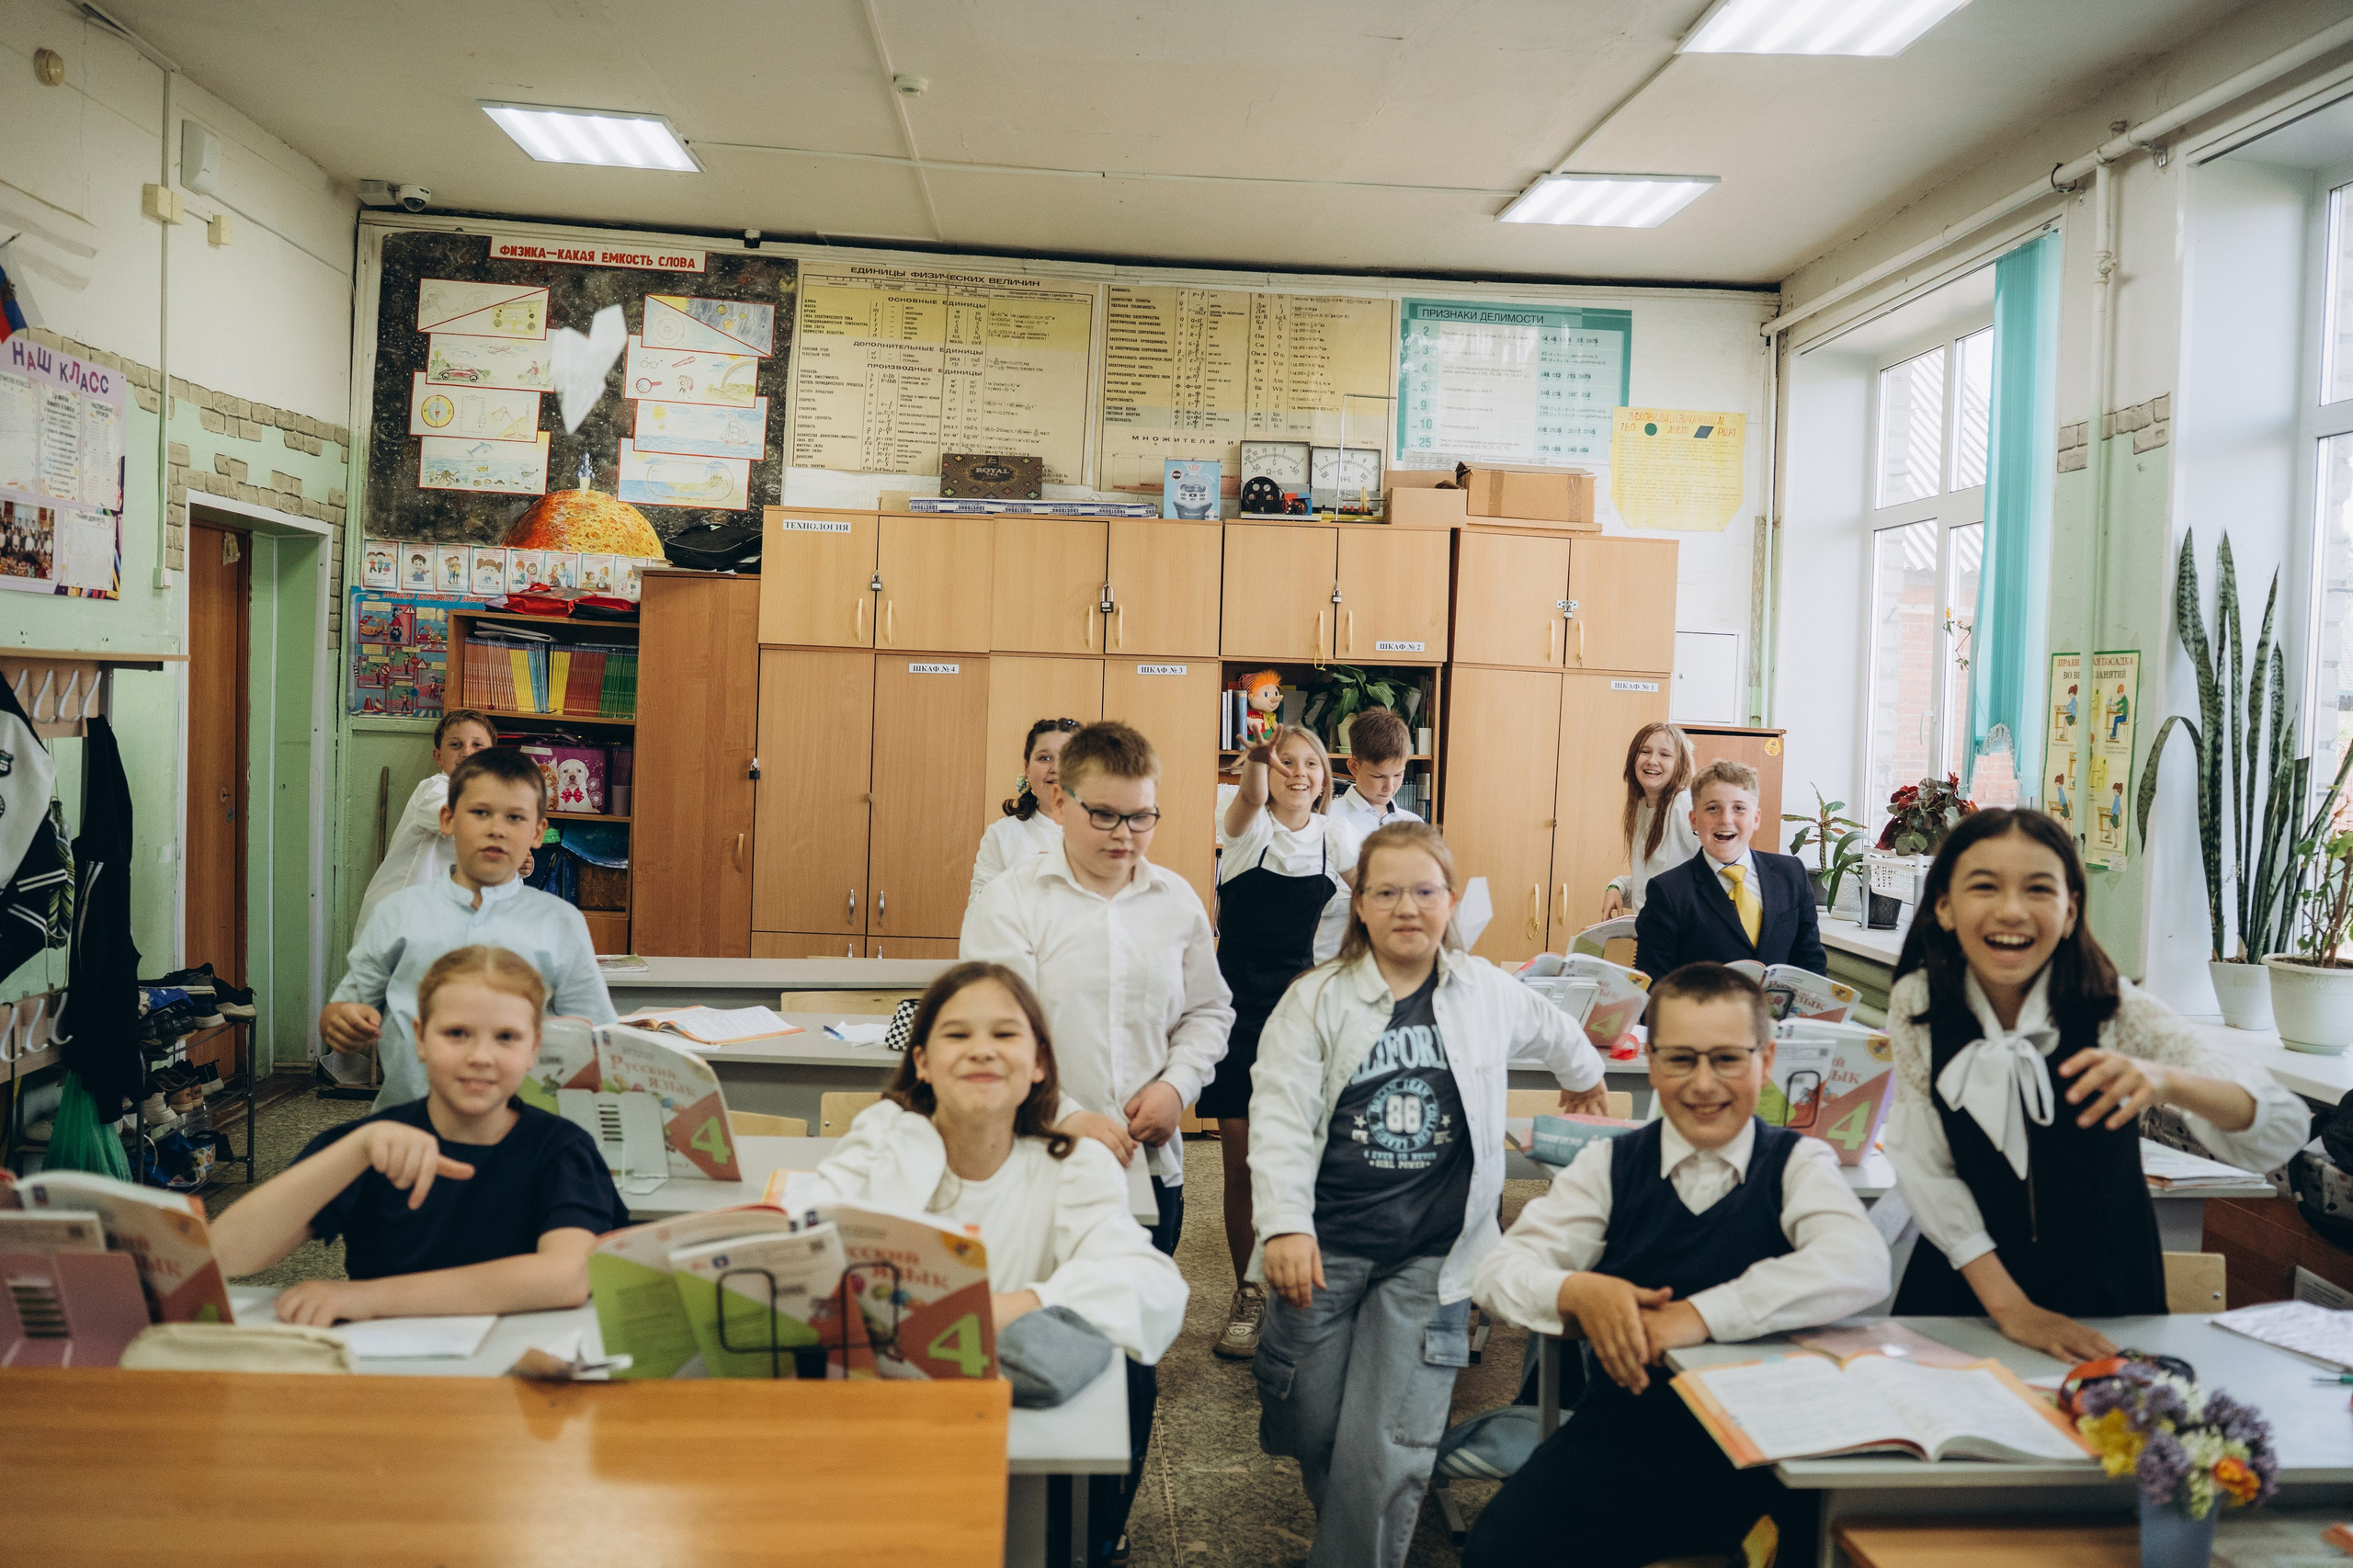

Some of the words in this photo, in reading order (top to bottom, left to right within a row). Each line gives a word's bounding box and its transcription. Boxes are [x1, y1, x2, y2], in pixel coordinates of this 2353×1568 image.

[601, 252, 653, 266] ЕМКОСТЬ
[658, 256, 695, 268] СЛОВА
[851, 267, 905, 277] ЕДИНИЦЫ
[911, 271, 984, 283] ФИЗИЧЕСКИХ
[989, 278, 1040, 287] ВЕЛИЧИН
[943, 301, 986, 309] ЕДИНИЦЫ
[1422, 309, 1478, 320] ПРИЗНАКИ
[1480, 312, 1544, 324] ДЕЛИМОСТИ
[1423, 326, 1429, 335] 2
[853, 341, 934, 352] ДОПОЛНИТЕЛЬНЫЕ
[1423, 346, 1428, 355] 3
[12, 341, 51, 374] НАШ
[60, 360, 108, 394] КЛАСС
[867, 363, 932, 372] ПРОИЗВОДНЫЕ
[938, 369, 982, 377] ЕДИНИЦЫ
[1421, 382, 1427, 392] 5
[1421, 401, 1427, 410] 9
[1420, 419, 1432, 429] 10
[1132, 436, 1215, 444] МНОЖИТЕЛИ
[1419, 437, 1431, 448] 25
[785, 522, 847, 530] ТЕХНОЛОГИЯ
[2101, 657, 2133, 665] ПОСАДКА
[2096, 669, 2126, 679] ЗАНЯТИЙ
[1590, 1012, 1625, 1039] 4
[610, 1055, 677, 1078] Русский
[1826, 1100, 1871, 1150] 4
[690, 1116, 732, 1164] 4
[927, 1312, 990, 1377] 4
